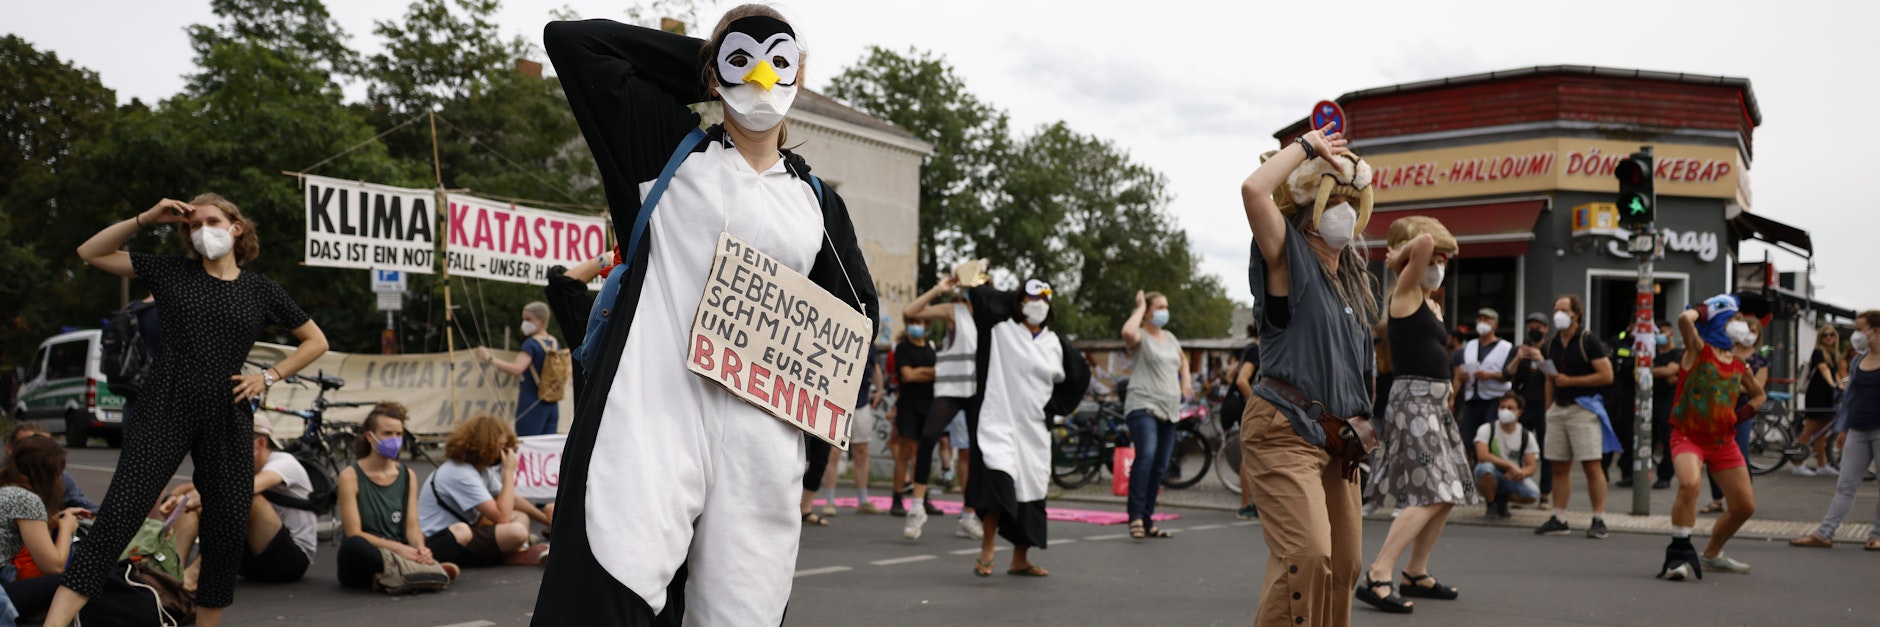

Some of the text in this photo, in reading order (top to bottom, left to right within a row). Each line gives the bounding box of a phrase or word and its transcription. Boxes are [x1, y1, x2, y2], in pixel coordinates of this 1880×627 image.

[1371, 149, 1731, 190] ALAFEL-HALLOUMI DÖN KEBAP
[310, 185, 605, 262] KLIMA KATASTRO
[310, 239, 341, 260] DAS
[347, 243, 368, 262] IST
[374, 245, 397, 264] EIN
[403, 248, 433, 267] NOT
[490, 257, 530, 279] UNSER
[726, 239, 778, 276] MEIN
[707, 286, 853, 383] SCHMILZT!
[716, 257, 863, 359] LEBENSRAUM
[694, 334, 852, 447] BRENNT!
[701, 311, 829, 395] UND EURER
[514, 452, 562, 488] AUG
